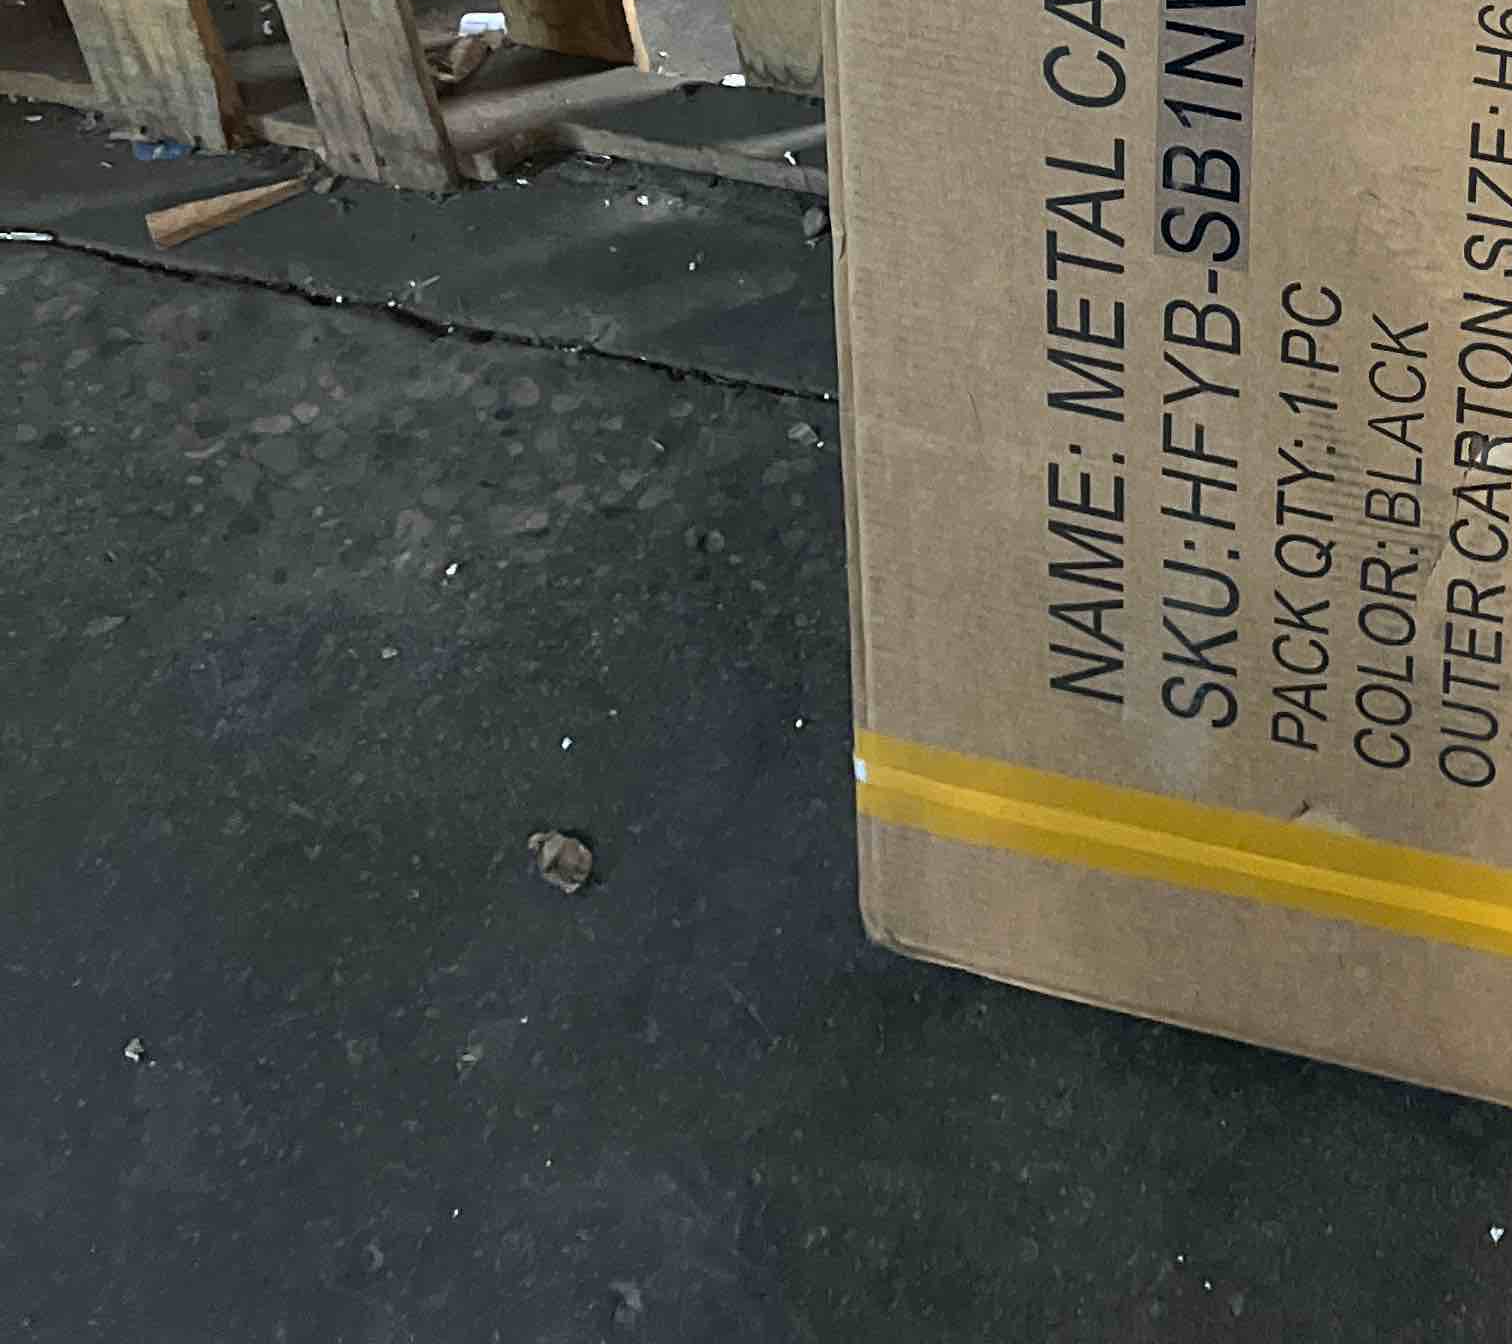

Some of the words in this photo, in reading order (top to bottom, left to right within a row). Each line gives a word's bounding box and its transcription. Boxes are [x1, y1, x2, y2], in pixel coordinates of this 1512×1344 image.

[1045, 137, 1127, 423] METAL
[1048, 443, 1127, 705] NAME:
[1271, 591, 1331, 752] PACK
[1439, 576, 1507, 789] OUTER
